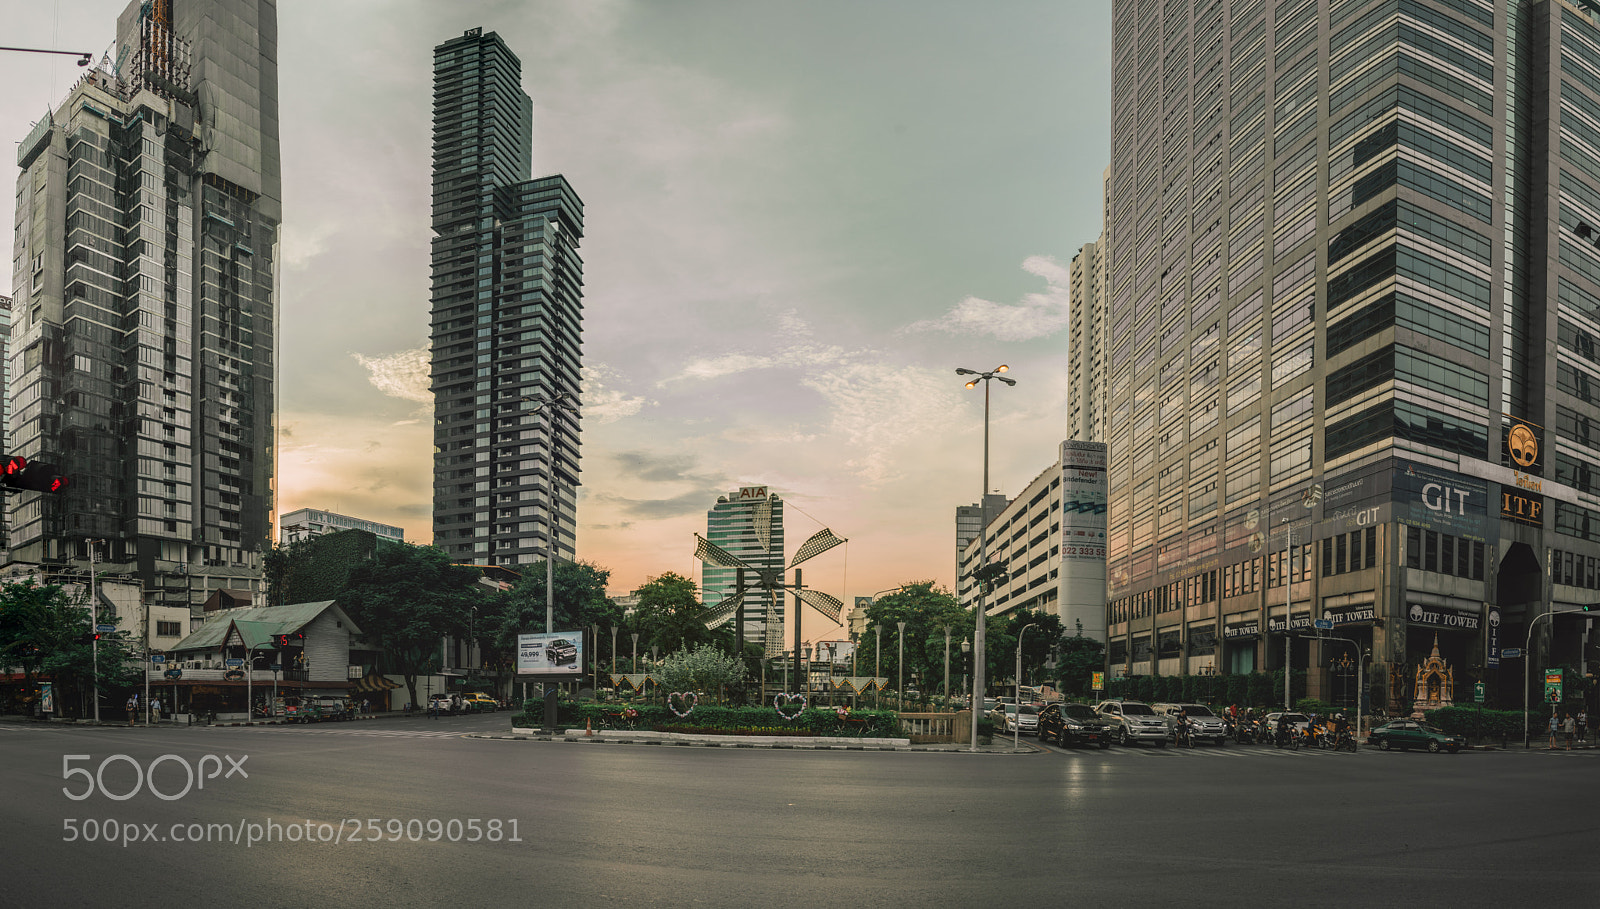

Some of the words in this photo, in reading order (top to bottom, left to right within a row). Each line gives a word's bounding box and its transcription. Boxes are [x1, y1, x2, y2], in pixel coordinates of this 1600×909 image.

[1063, 476, 1097, 485] Bitdefender
[1078, 470, 1098, 478] New!
[1513, 469, 1542, 493] ไอทีเอฟ
[740, 487, 766, 498] AIA
[1421, 483, 1470, 516] GIT
[1503, 493, 1542, 519] ITF
[1356, 506, 1380, 526] GIT
[1062, 547, 1077, 555] 022
[1079, 547, 1094, 555] 333
[1332, 613, 1344, 623] ITF
[1345, 609, 1374, 622] TOWER
[1422, 611, 1440, 624] ITF
[1442, 613, 1479, 629] TOWER
[1276, 621, 1286, 631] ITF
[1290, 618, 1310, 629] OWER
[1230, 628, 1239, 637] ITF
[1239, 626, 1258, 636] TOWER
[520, 651, 540, 659] 49,999
